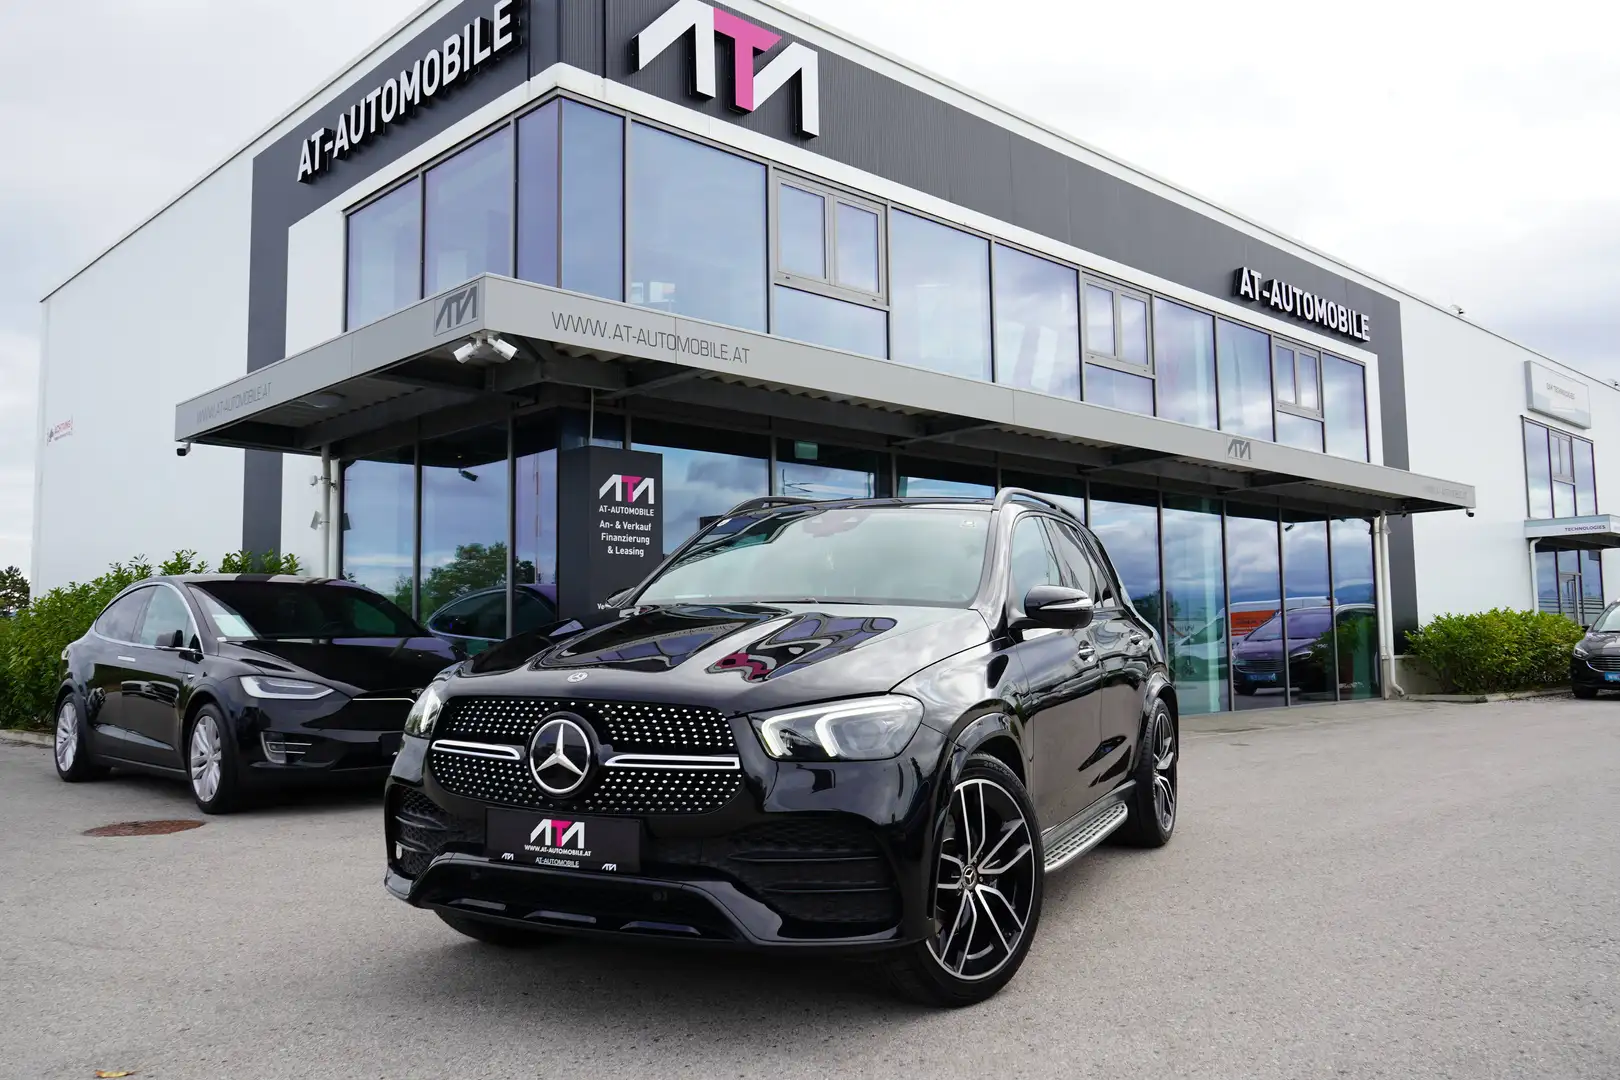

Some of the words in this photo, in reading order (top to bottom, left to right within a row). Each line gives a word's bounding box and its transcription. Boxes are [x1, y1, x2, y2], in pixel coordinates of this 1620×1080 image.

[638, 0, 819, 137] ATA
[297, 0, 513, 182] AT-AUTOMOBILE
[1240, 266, 1370, 342] AT-AUTOMOBILE
[551, 311, 750, 364] WWW.AT-AUTOMOBILE.AT
[598, 474, 655, 504] ATA
[598, 505, 655, 517] AT-AUTOMOBILE
[599, 520, 613, 529] An-
[615, 520, 621, 529] &
[622, 521, 652, 532] Verkauf
[601, 532, 650, 546] Finanzierung
[607, 545, 614, 555] &
[615, 546, 645, 558] Leasing
[530, 818, 585, 849] ATA
[524, 844, 592, 857] WWW.AT-AUTOMOBILE.AT
